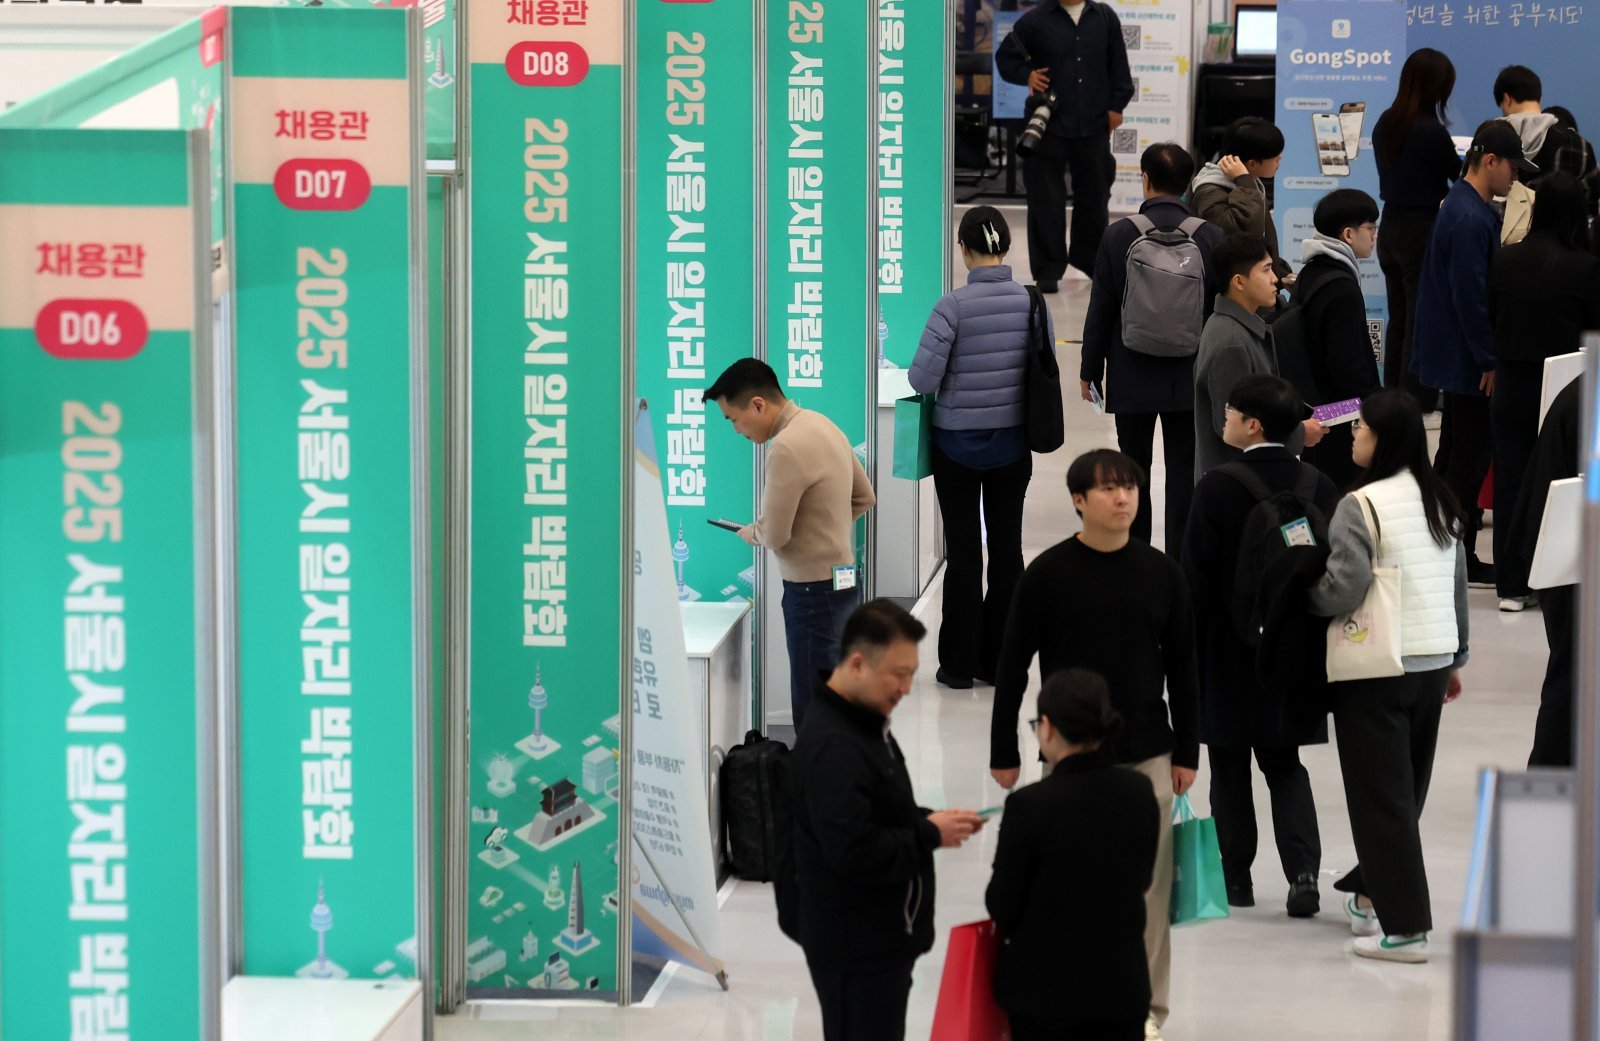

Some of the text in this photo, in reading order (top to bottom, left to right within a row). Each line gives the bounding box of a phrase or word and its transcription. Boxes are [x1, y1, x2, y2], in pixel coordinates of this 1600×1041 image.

[507, 0, 589, 27] 채용관
[524, 51, 569, 76] D08
[1289, 48, 1392, 69] GongSpot
[1464, 3, 1500, 26] 위한
[275, 110, 369, 141] 채용관
[788, 50, 824, 159] 서울시
[295, 169, 347, 199] D07
[787, 165, 824, 273] 일자리
[36, 242, 146, 279] 채용관
[665, 31, 706, 506] 2025 서울시 일자리 박람회
[59, 311, 121, 345] D06
[787, 281, 824, 388] 박람회
[523, 117, 569, 647] 2025 서울시 일자리 박람회
[61, 401, 123, 543] 2025
[295, 246, 354, 860] 2025 서울시 일자리 박람회
[64, 553, 127, 733] 서울시
[66, 743, 128, 921] 일자리
